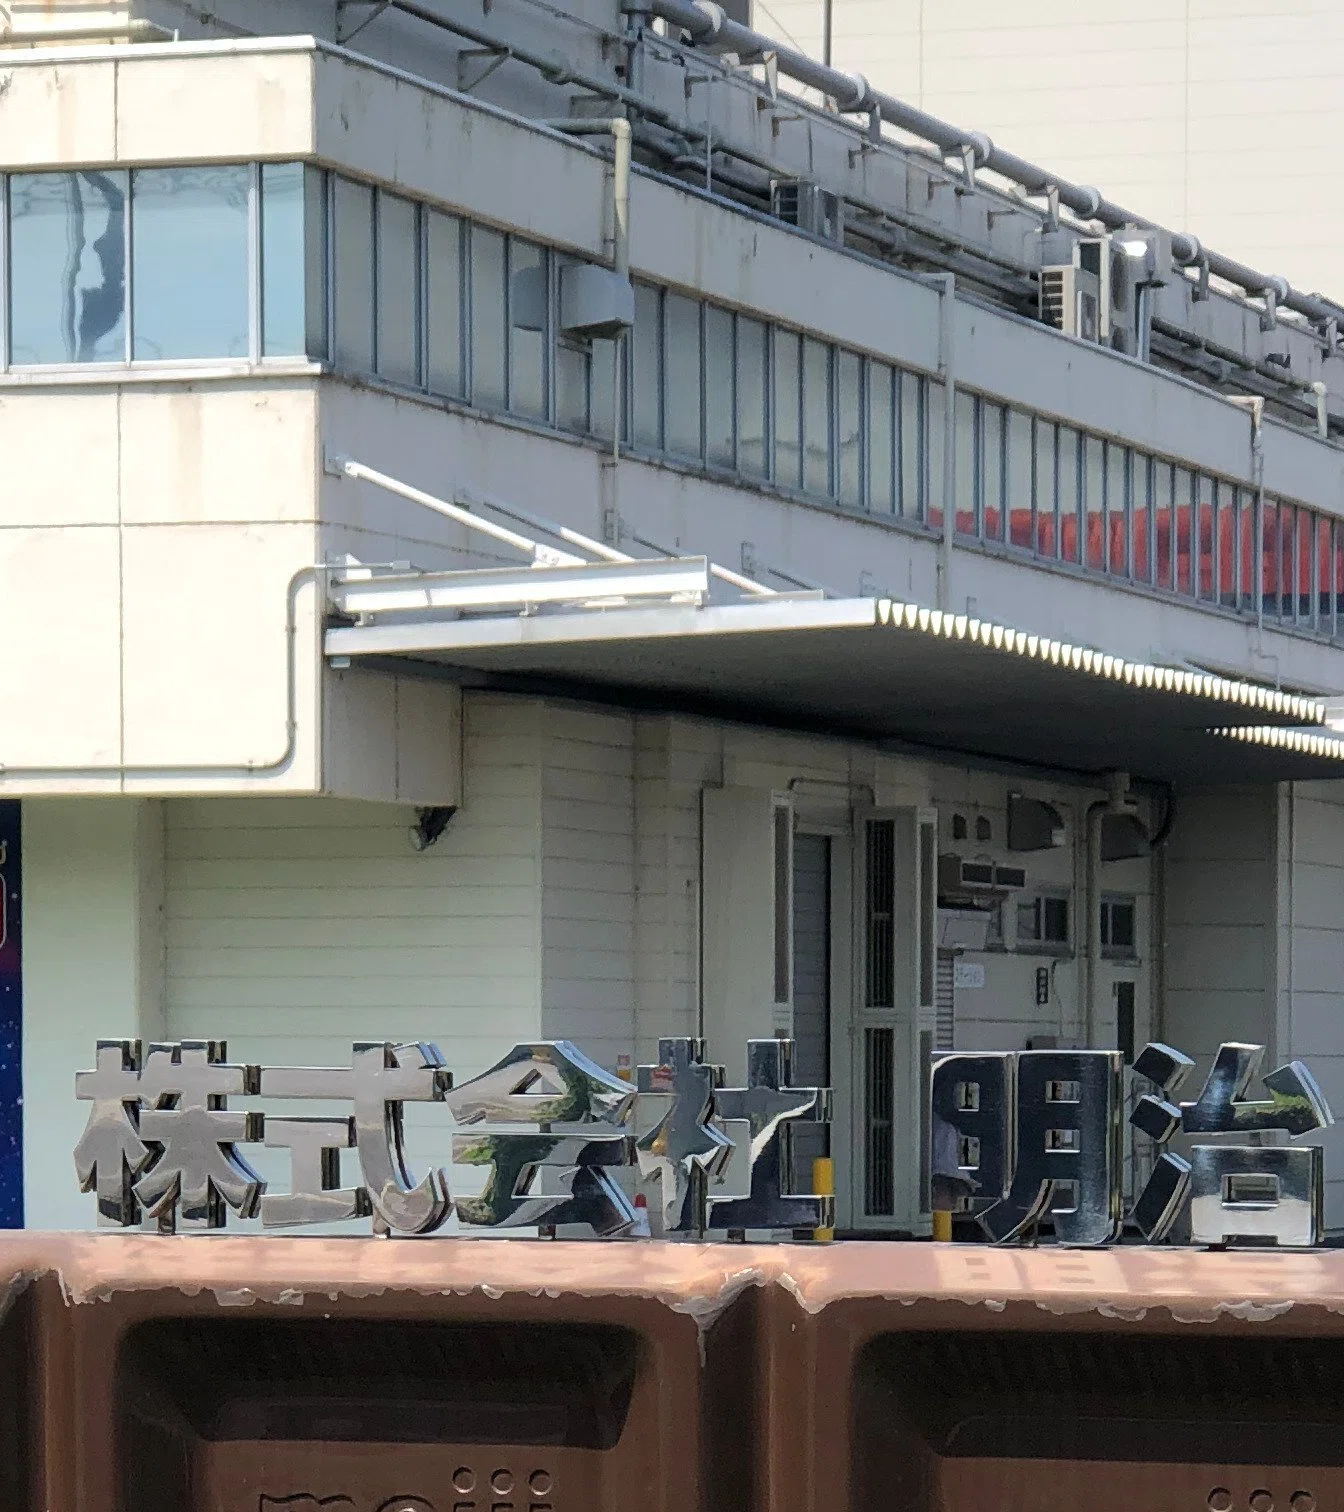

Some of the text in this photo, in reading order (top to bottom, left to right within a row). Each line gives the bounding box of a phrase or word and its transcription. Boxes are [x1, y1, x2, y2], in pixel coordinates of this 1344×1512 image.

[74, 1037, 834, 1238] 株式会社
[930, 1040, 1332, 1248] 明治
